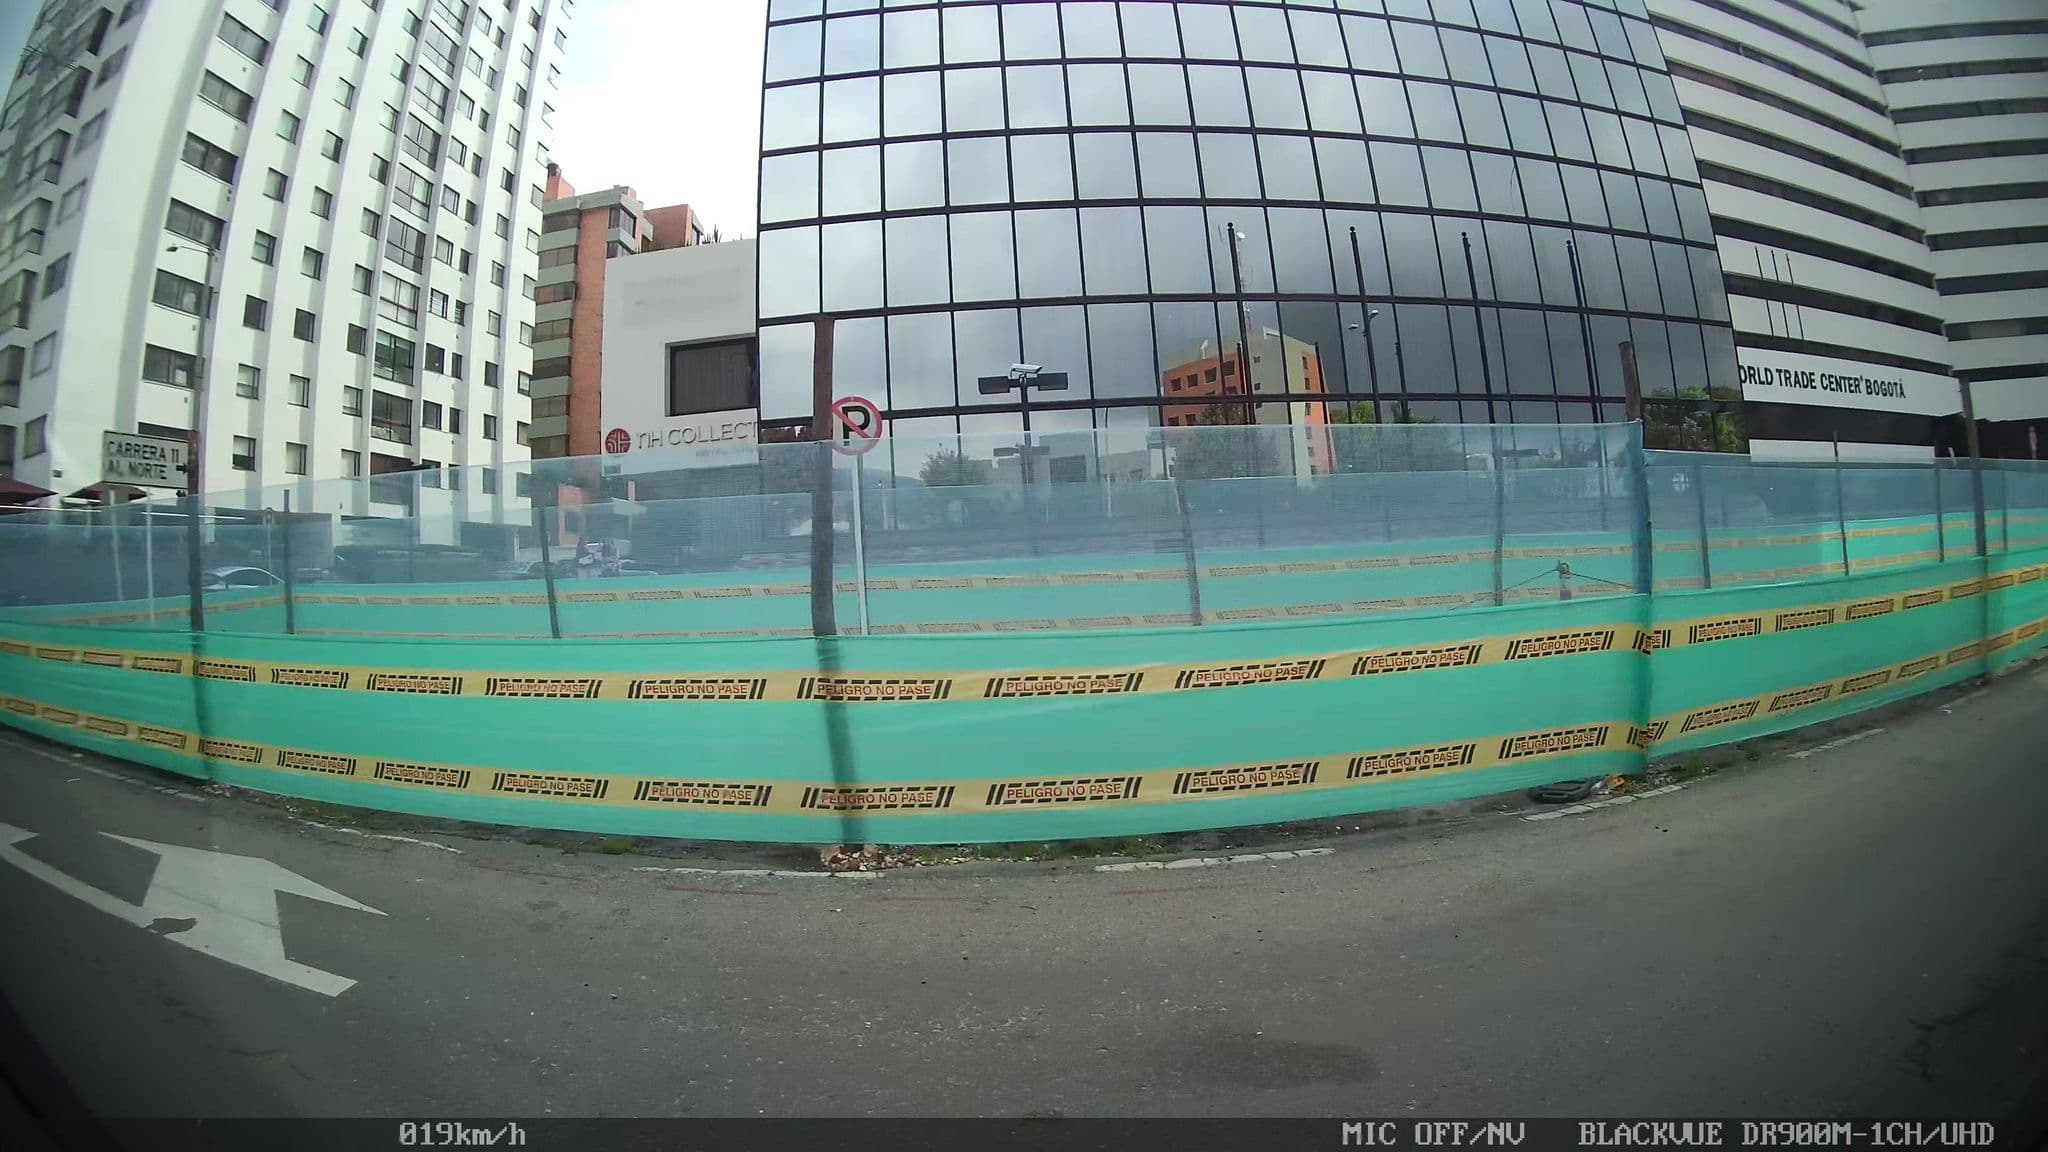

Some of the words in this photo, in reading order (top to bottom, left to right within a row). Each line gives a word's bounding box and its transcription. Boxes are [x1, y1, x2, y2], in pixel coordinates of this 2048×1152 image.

[1776, 368, 1817, 390] TRADE
[1865, 378, 1906, 399] BOGOTÁ
[107, 441, 167, 462] CARRERA
[171, 448, 180, 464] 11
[107, 460, 125, 478] AL
[128, 461, 167, 480] NORTE
[1521, 640, 1561, 653] PELIGRO
[1563, 638, 1577, 649] NO
[1579, 636, 1601, 647] PASE
[1370, 656, 1419, 669] PELIGRO
[1421, 654, 1437, 664] NO
[1440, 651, 1465, 663] PASE
[1196, 670, 1250, 682] PELIGRO
[1254, 668, 1272, 679] NO
[1276, 666, 1307, 677] PASE
[645, 684, 694, 695] PELIGRO
[698, 684, 715, 695] NO
[718, 684, 748, 695] PASE
[818, 684, 871, 696] PELIGRO
[876, 685, 894, 696] NO
[900, 685, 931, 696] PASE
[1007, 680, 1063, 692] PELIGRO
[1067, 679, 1086, 690] NO
[1090, 678, 1123, 688] PASE
[1515, 738, 1554, 751] PELIGRO
[1557, 736, 1571, 746] NO
[1573, 733, 1595, 744] PASE
[1365, 757, 1412, 771] PELIGRO
[1414, 754, 1430, 765] NO
[1433, 750, 1459, 763] PASE
[385, 767, 418, 778] PELIGRO
[420, 771, 434, 780] NO
[436, 772, 457, 782] PASE
[1193, 774, 1246, 787] PELIGRO
[1250, 772, 1267, 783] NO
[1270, 769, 1300, 781] PASE
[507, 778, 547, 789] PELIGRO
[550, 781, 564, 790] NO
[567, 782, 592, 792] PASE
[652, 786, 699, 798] PELIGRO
[703, 788, 719, 799] NO
[1007, 787, 1062, 799] PELIGRO
[1067, 785, 1086, 796] NO
[1090, 783, 1121, 795] PASE
[879, 793, 897, 803] NO
[901, 792, 933, 803] PASE
